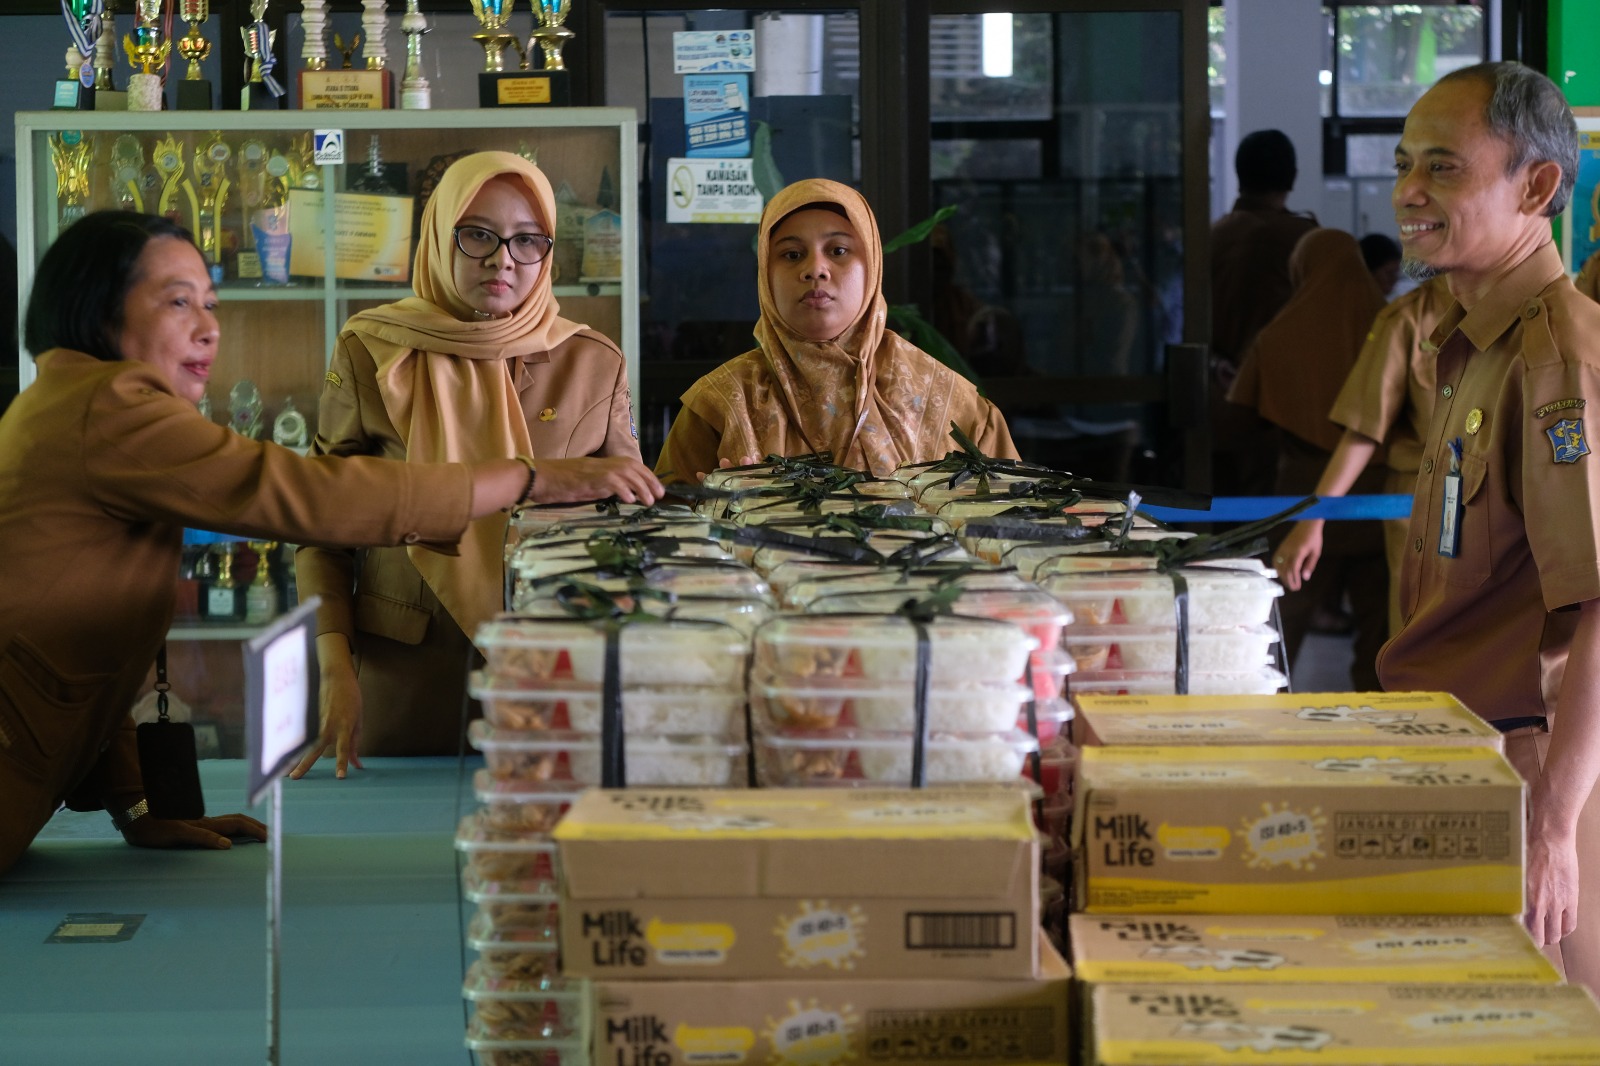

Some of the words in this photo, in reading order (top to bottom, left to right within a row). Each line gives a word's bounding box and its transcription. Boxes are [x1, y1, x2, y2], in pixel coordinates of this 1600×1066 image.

[706, 169, 748, 181] KAWASAN
[697, 184, 724, 196] TANPA
[726, 184, 756, 196] ROKOK
[1094, 813, 1152, 841] Milk
[1260, 824, 1276, 841] ISI
[1338, 813, 1397, 829] JANGAN
[1104, 842, 1155, 868] Life
[582, 909, 644, 938] Milk
[592, 939, 647, 967] Life
[606, 1015, 669, 1043] Milk
[617, 1044, 672, 1066] Life
